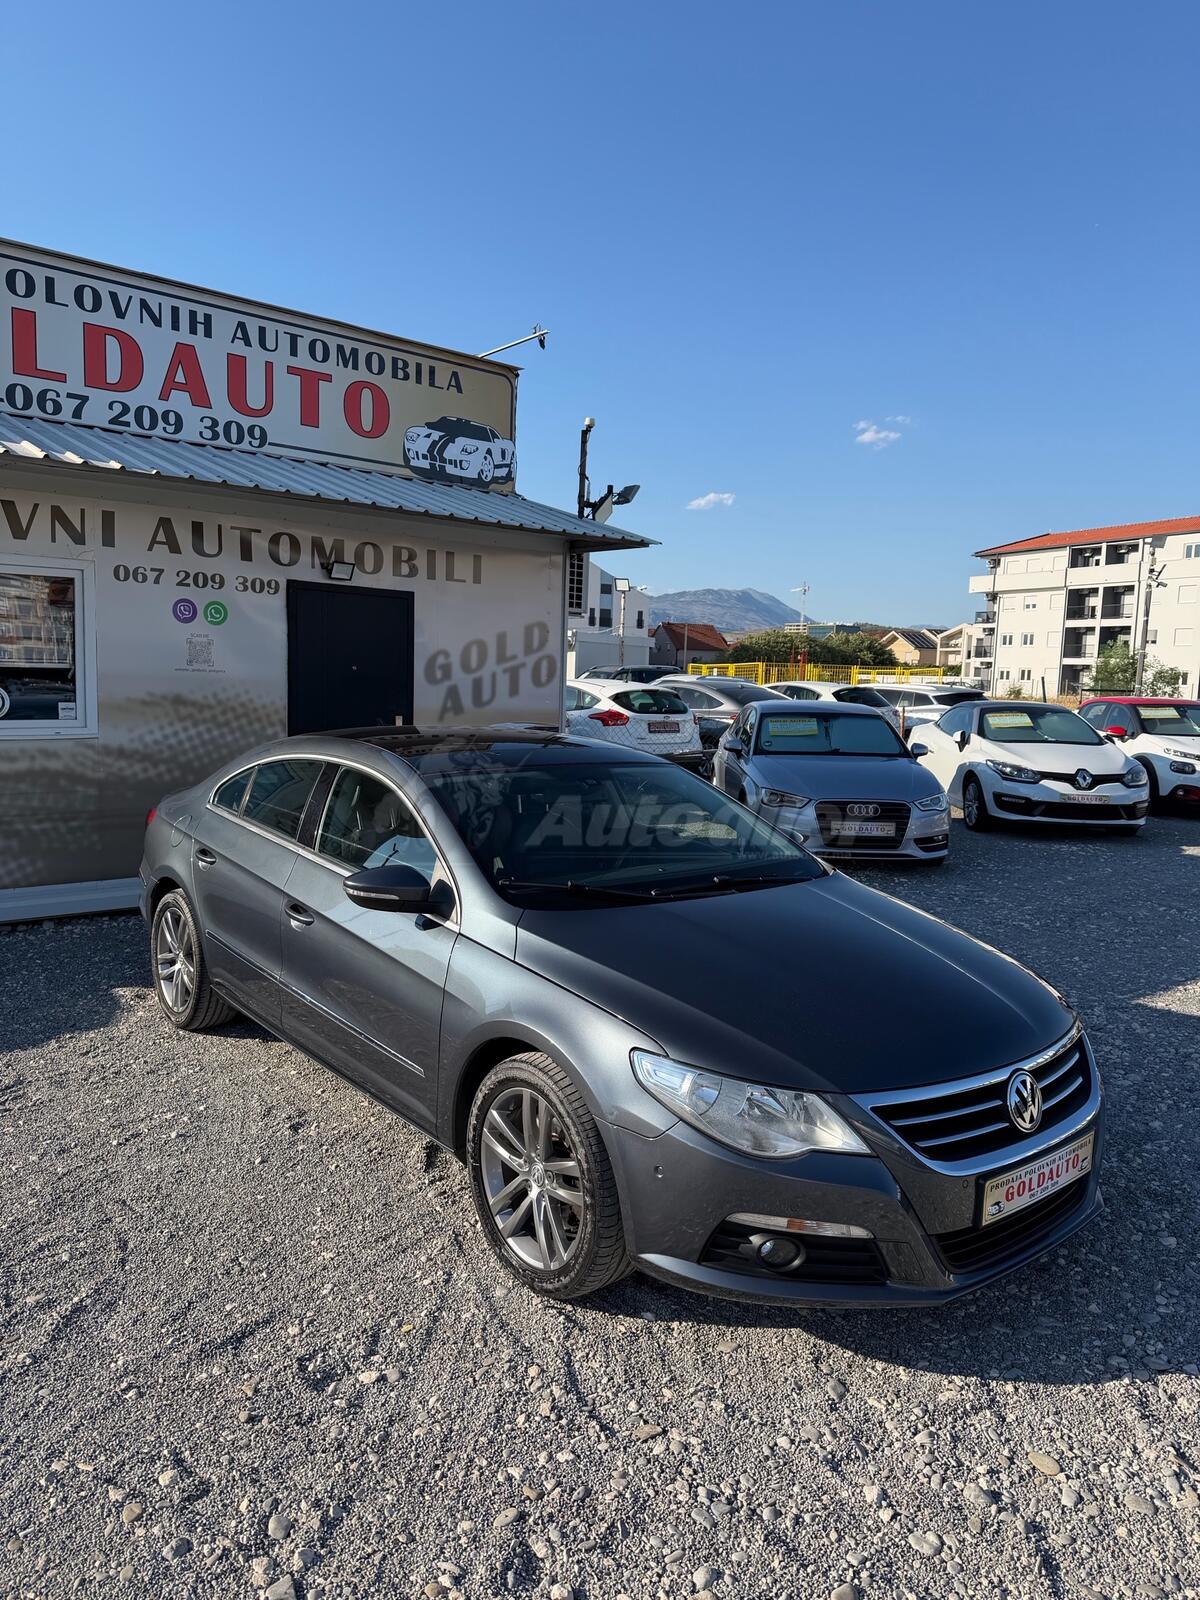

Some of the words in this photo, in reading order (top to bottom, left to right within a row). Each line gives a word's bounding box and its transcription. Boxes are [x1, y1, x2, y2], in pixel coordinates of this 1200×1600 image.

[11, 306, 390, 439] LDAUTO
[230, 320, 463, 394] AUTOMOBILA
[108, 400, 184, 435] 209
[199, 416, 268, 449] 309
[113, 564, 165, 585] 067
[175, 570, 226, 590] 209
[235, 575, 281, 595] 309
[147, 516, 482, 584] AUTOMOBILI
[423, 620, 550, 686] GOLD
[438, 654, 557, 722] AUTO
[990, 1173, 1023, 1192] PRODAJA
[1024, 1157, 1057, 1176] POLOVNIH
[1057, 1138, 1091, 1162] AUTOMOBILA
[1004, 1153, 1080, 1202] GOLDAUTO
